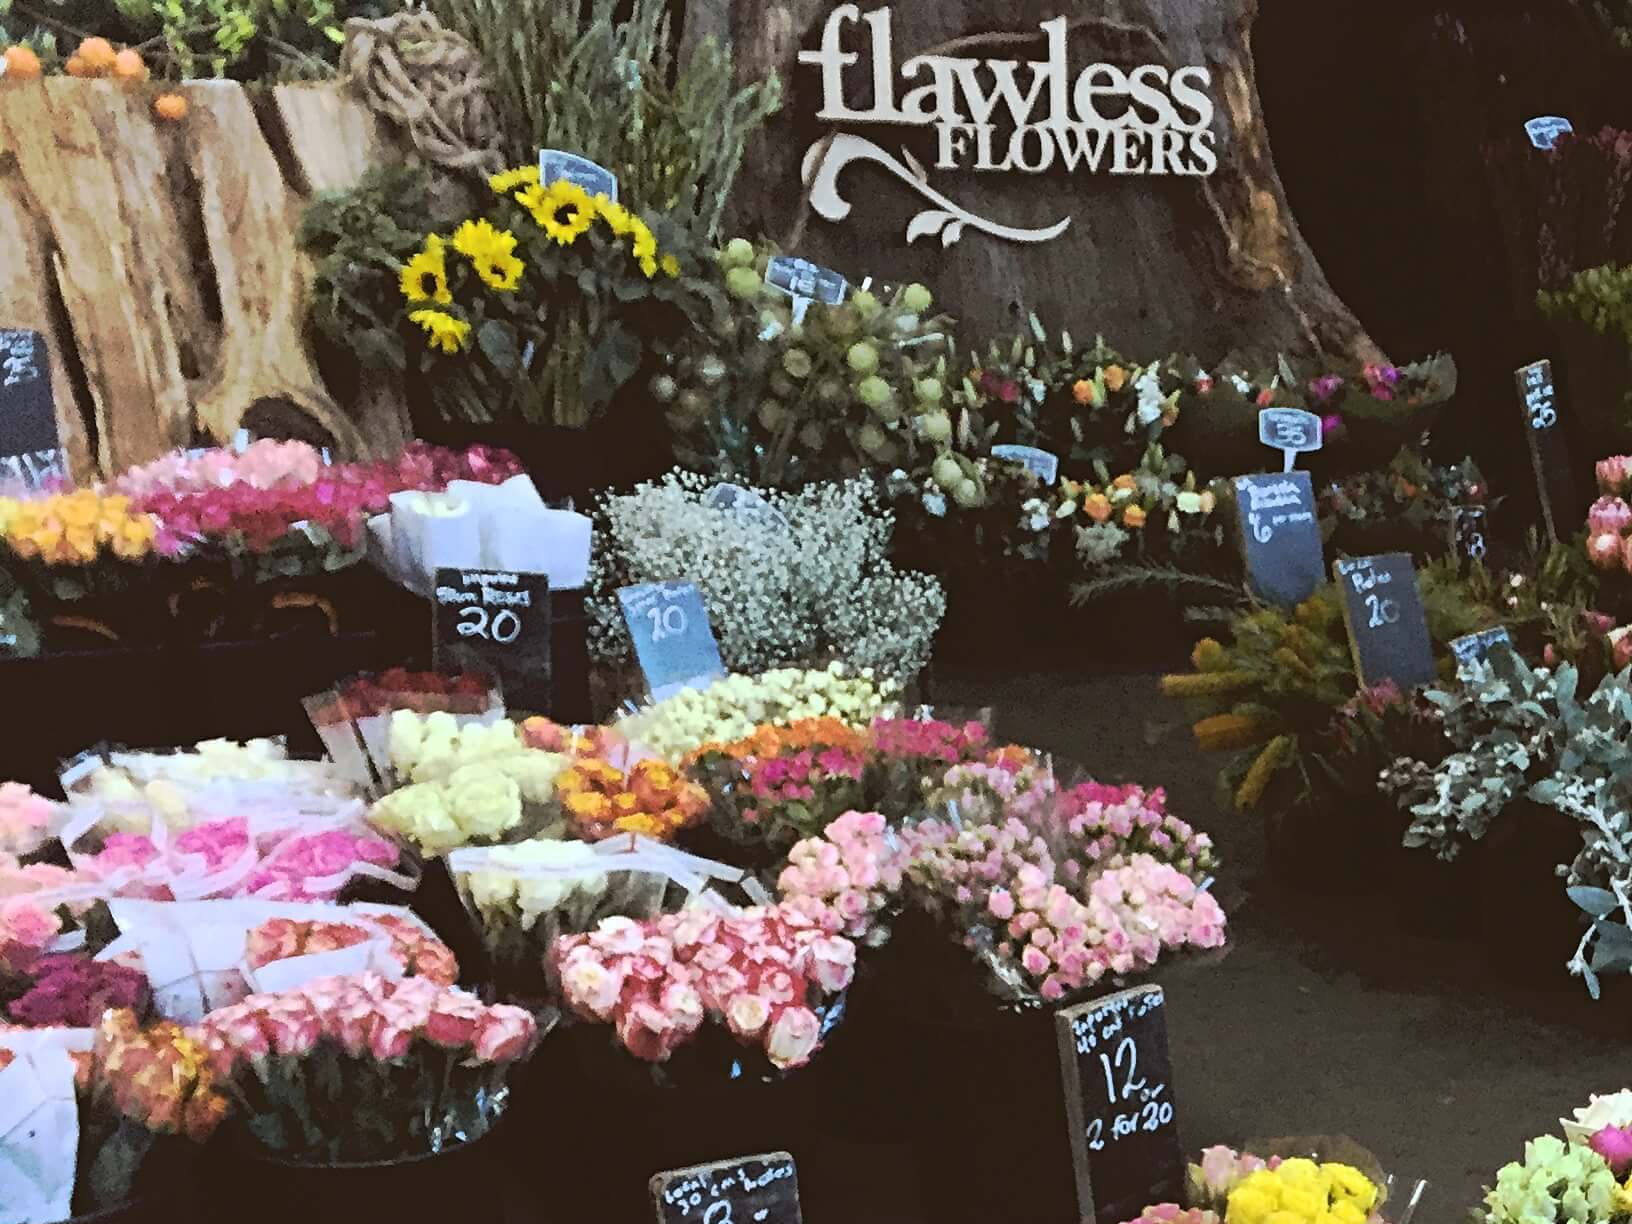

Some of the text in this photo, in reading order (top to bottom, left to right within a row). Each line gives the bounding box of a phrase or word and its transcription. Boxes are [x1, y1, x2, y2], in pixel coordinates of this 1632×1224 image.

[798, 4, 1215, 131] flawless
[934, 121, 1218, 176] FLOWERS
[456, 606, 521, 642] 20
[647, 604, 688, 642] 10
[1100, 1036, 1147, 1104] 12
[1086, 1101, 1173, 1150] 2 for 20
